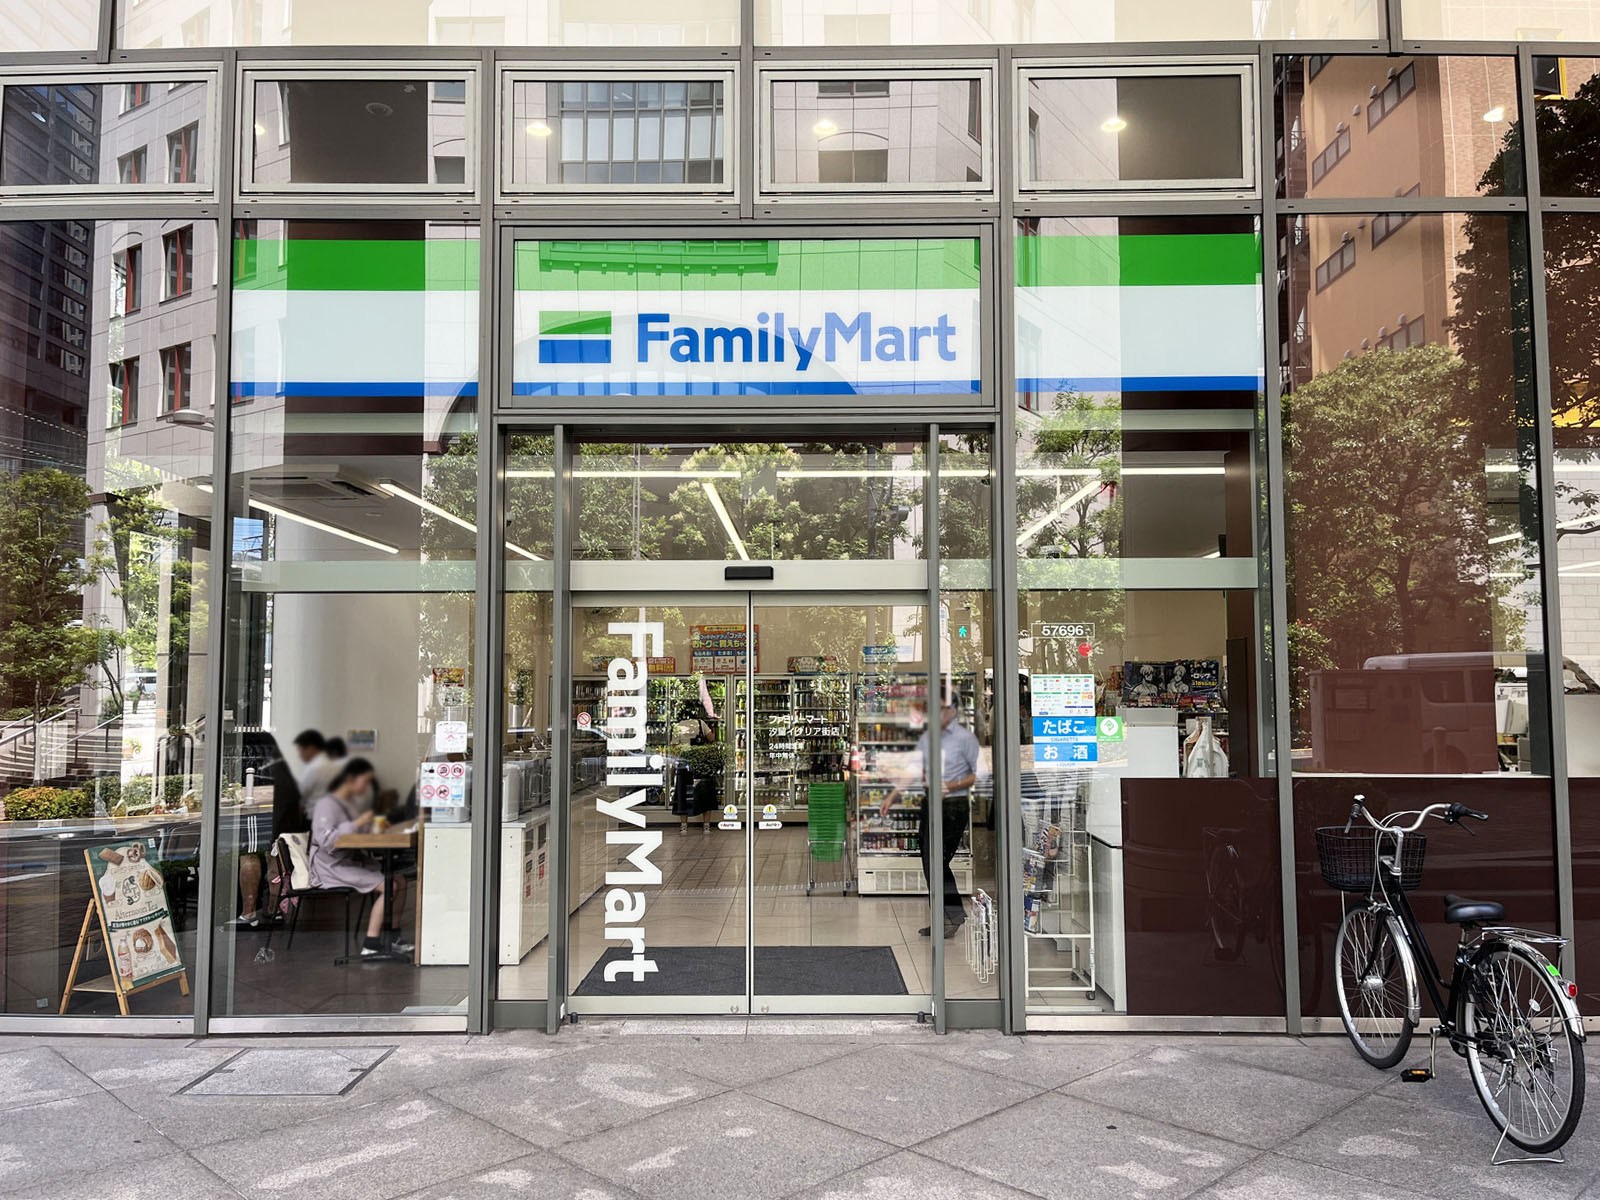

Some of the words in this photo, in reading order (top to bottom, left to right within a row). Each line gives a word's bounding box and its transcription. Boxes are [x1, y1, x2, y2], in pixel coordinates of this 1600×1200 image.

[637, 311, 957, 371] FamilyMart
[1041, 625, 1084, 636] 57696
[768, 714, 828, 724] ファミリーマート
[1042, 719, 1087, 735] たばこ
[595, 622, 664, 982] FamilyMart
[115, 906, 148, 920] Afternoon
[145, 900, 159, 912] Tea
